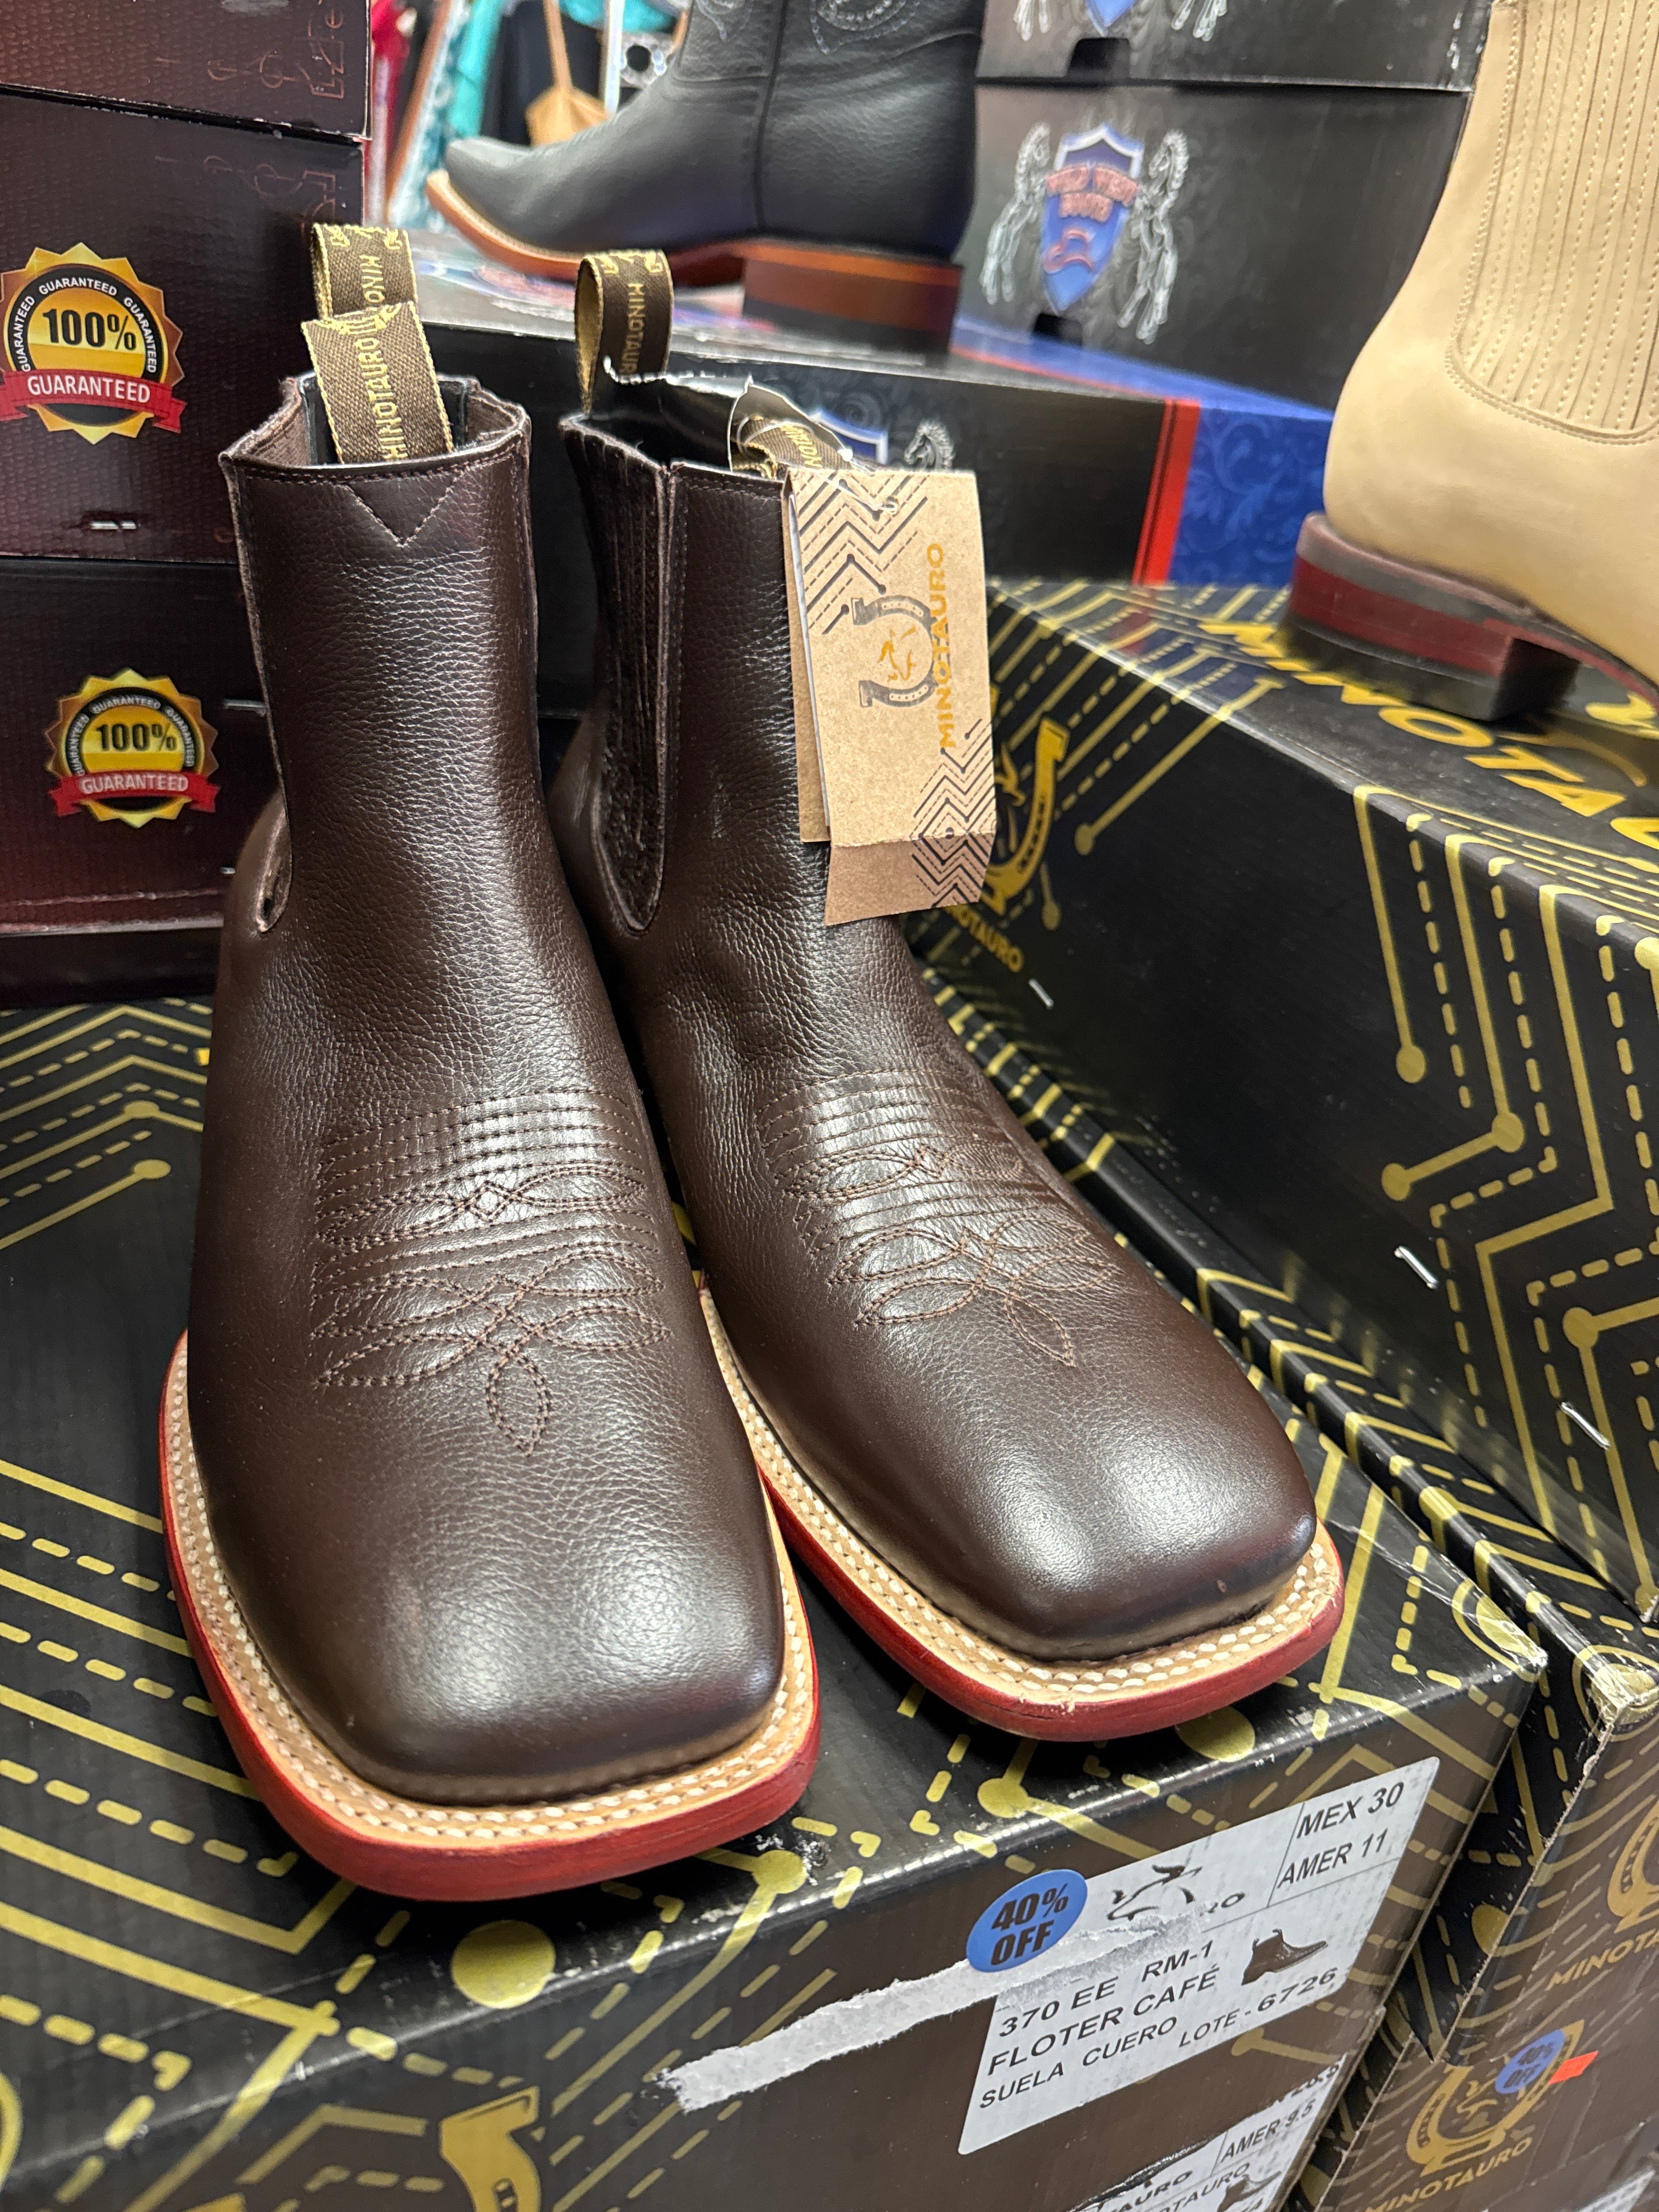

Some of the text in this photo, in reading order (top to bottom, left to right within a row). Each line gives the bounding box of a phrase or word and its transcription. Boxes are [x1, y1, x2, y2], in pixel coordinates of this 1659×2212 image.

[38, 277, 117, 296] GUARANTEED
[14, 296, 35, 372] GUARANTEED
[43, 309, 137, 351] 100%
[123, 297, 157, 373] GUARANTEED
[27, 375, 150, 403] GUARANTEED
[927, 543, 957, 748] MINOTAURO
[91, 695, 161, 714] GUARANTEED
[70, 713, 89, 776] GUARANTEED
[96, 723, 177, 752] 100%
[166, 706, 194, 767] GUARANTEED
[81, 774, 189, 794] GUARANTEED
[1297, 1782, 1404, 1838] MEX 30
[1277, 1828, 1387, 1888] AMER 11
[991, 1883, 1068, 1931] 40%
[991, 1920, 1054, 1965] OFF
[1000, 1940, 1213, 2037] 370 EE RM-1
[1179, 2008, 1240, 2047] LOTE
[1257, 1967, 1338, 2012] 6726
[988, 1963, 1220, 2076] FLOTER CAFÉ
[979, 2017, 1177, 2108] SUELA CUERO
[1221, 2098, 1316, 2163] AMER 9.5
